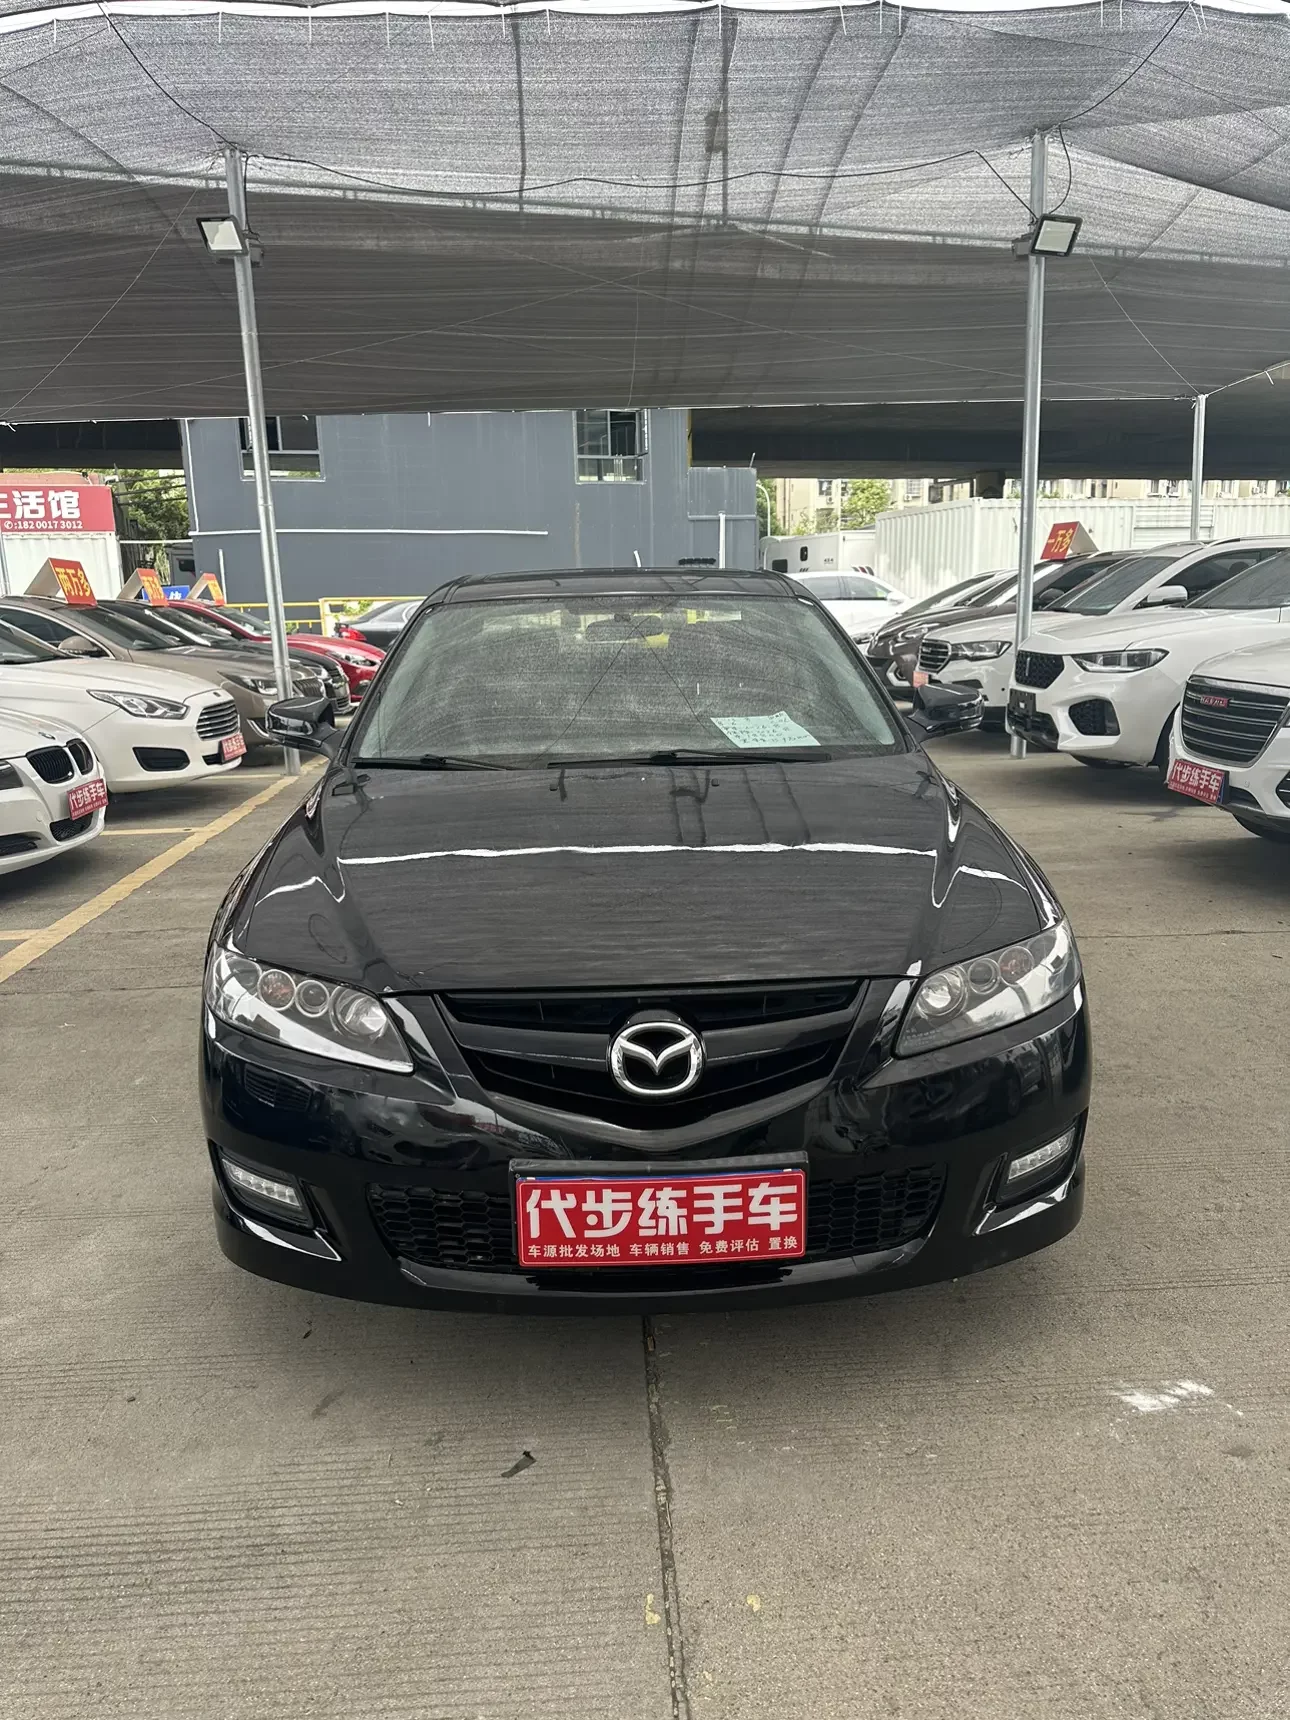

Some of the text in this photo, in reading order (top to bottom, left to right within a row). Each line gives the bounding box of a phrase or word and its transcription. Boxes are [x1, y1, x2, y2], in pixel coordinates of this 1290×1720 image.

[1048, 528, 1074, 552] 一万多
[55, 567, 90, 597] 两万多
[1172, 762, 1221, 792] 代步练手车
[70, 783, 105, 810] 代步练手车
[526, 1182, 798, 1238] 代步练手车
[528, 1235, 798, 1258] 车源批发场地 车辆销售 免费评估 置换
